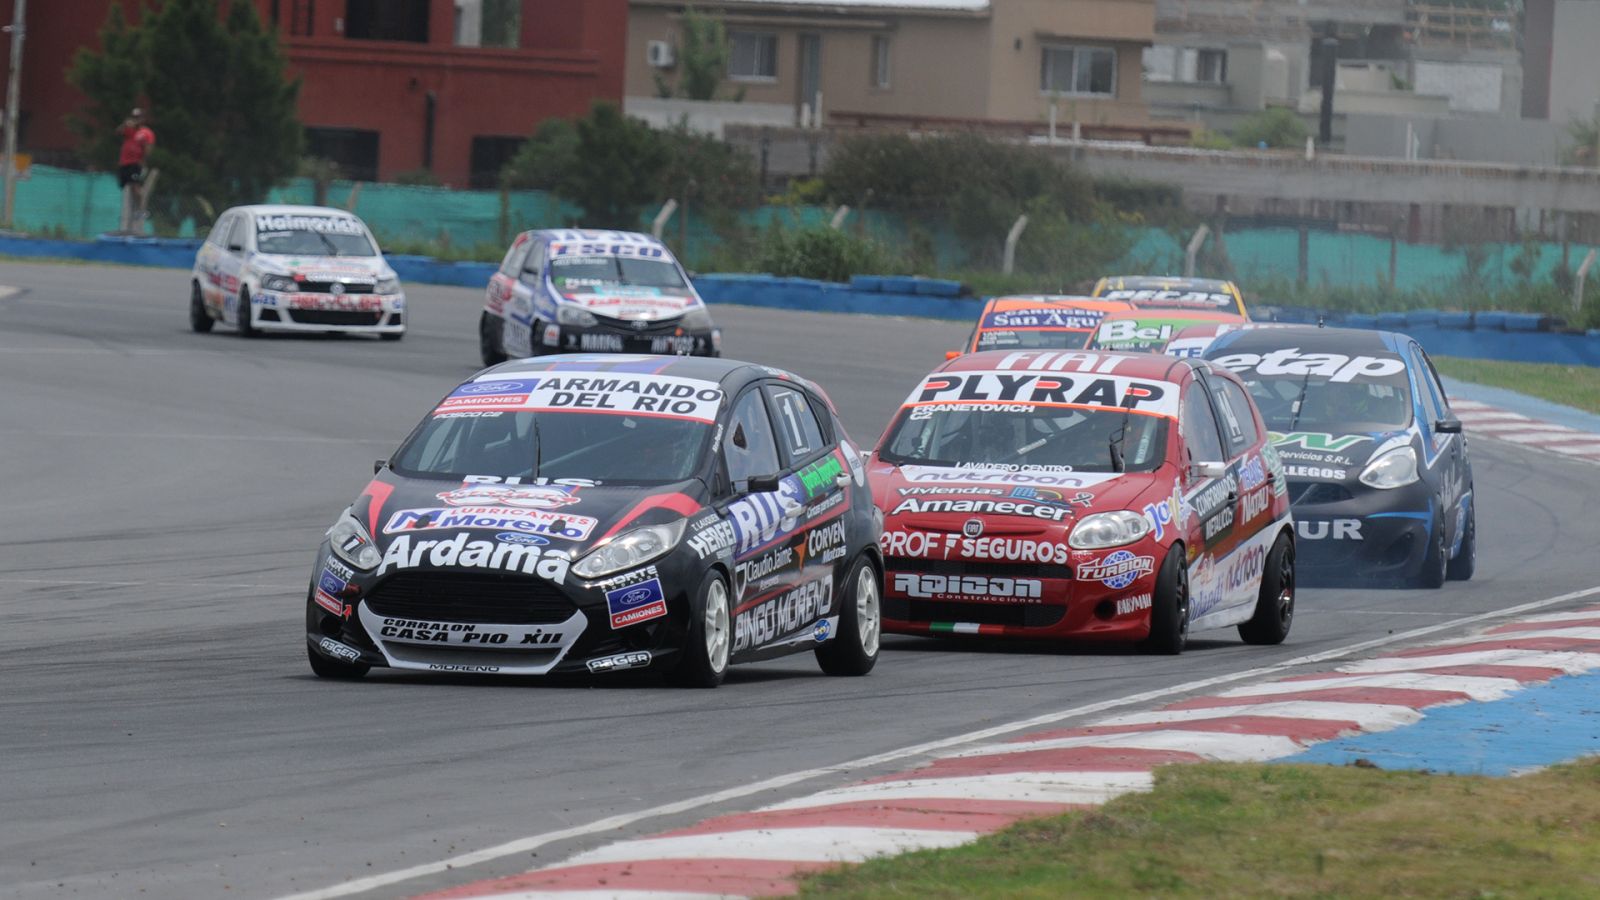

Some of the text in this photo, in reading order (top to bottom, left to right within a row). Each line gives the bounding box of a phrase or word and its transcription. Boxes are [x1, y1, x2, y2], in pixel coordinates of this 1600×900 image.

[993, 314, 1038, 326] San
[1098, 319, 1172, 342] Bel
[995, 352, 1141, 374] FIAT
[1210, 347, 1405, 382] etap
[537, 378, 721, 402] ARMANDO
[918, 374, 1165, 409] PLYRAP
[442, 396, 523, 406] CAMIONES
[548, 392, 697, 414] DEL RIO
[911, 404, 1035, 413] FRANETOVICH
[909, 412, 932, 421] C2
[954, 462, 1073, 473] LAVADERO CENTRO
[1279, 450, 1354, 466] Servicios S.R.L.
[913, 472, 1084, 486] nutribon
[450, 508, 590, 525] LUBRICANTES
[728, 480, 799, 554] RUS
[891, 498, 1073, 522] Amanecer
[441, 514, 583, 538] Moreno
[1293, 519, 1364, 540] UR
[505, 533, 539, 543] Ford
[808, 517, 846, 557] CORVEN
[376, 533, 571, 585] Ardama
[960, 536, 1068, 565] SEGUROS
[747, 553, 773, 582] Claudio
[773, 546, 792, 570] Jaime
[1081, 558, 1151, 579] TURBION
[600, 565, 658, 589] NORTE
[626, 591, 646, 603] Ford
[937, 593, 1042, 604] Construcciones
[614, 604, 663, 624] CAMIONES
[732, 574, 833, 652] BINGO MORENO
[380, 626, 449, 643] CASA
[462, 633, 509, 644] PIO
[383, 618, 476, 632] CORRALON
[428, 664, 500, 672] MORENO
